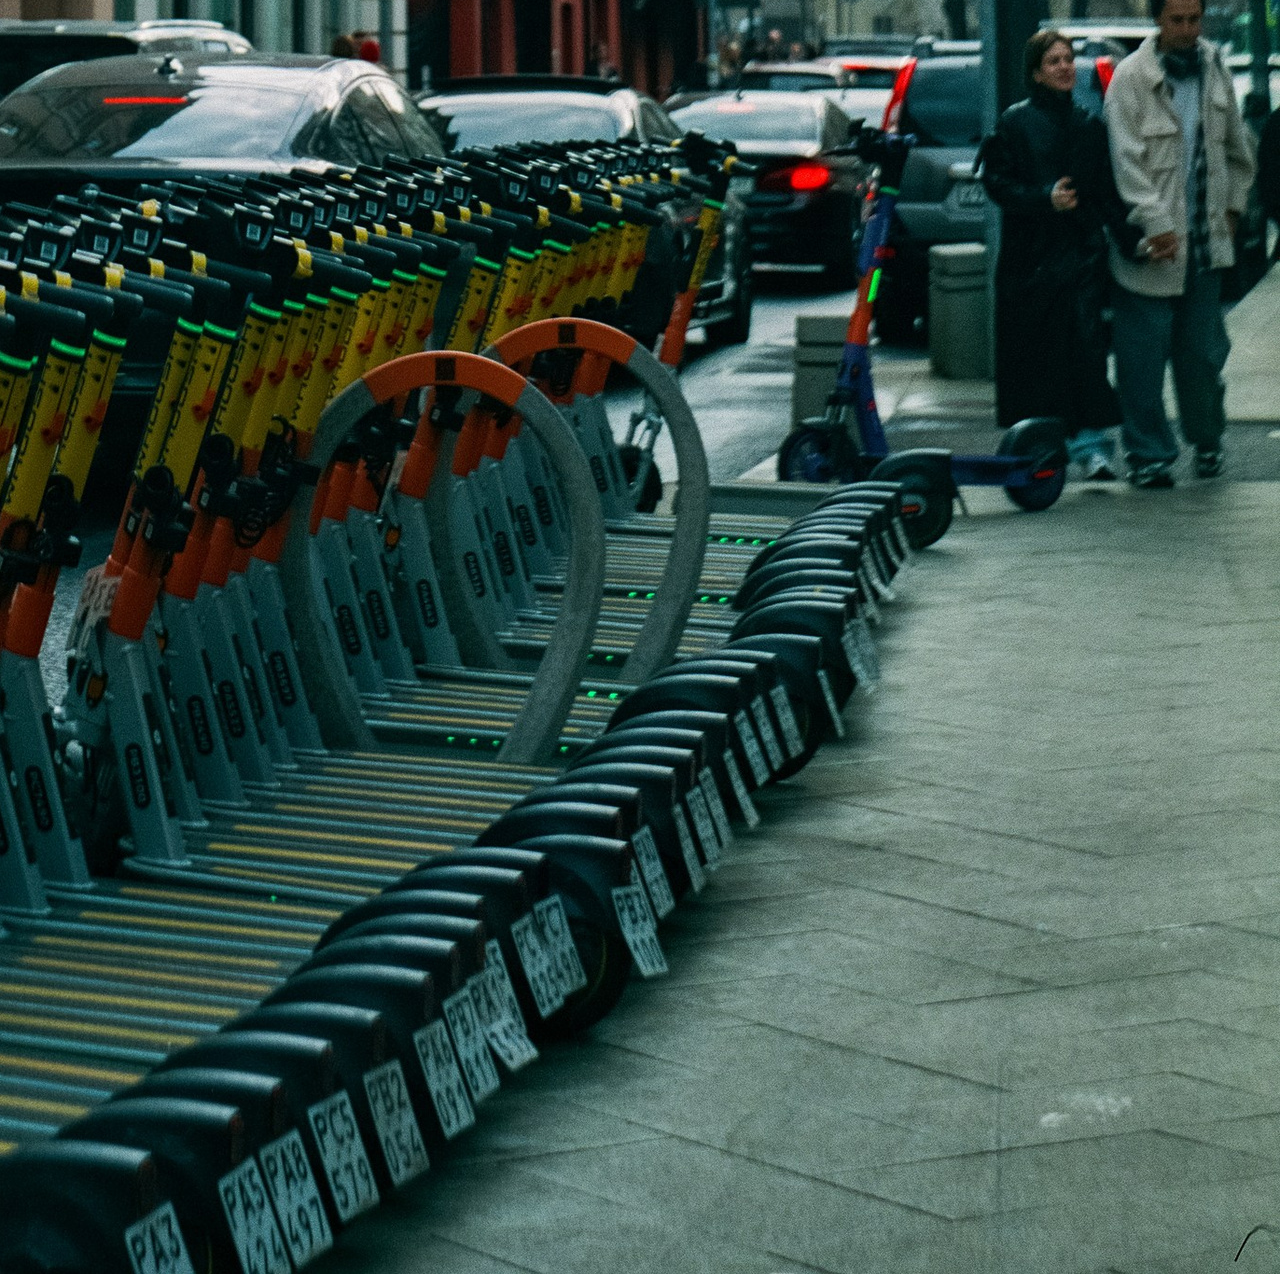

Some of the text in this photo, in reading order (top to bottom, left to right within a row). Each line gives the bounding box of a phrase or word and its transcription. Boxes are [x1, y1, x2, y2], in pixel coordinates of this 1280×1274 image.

[366, 1069, 407, 1121] PB2
[312, 1097, 357, 1155] PC5
[383, 1120, 424, 1177] 054
[222, 1166, 269, 1228] PA5
[263, 1137, 308, 1198] PA8
[330, 1150, 374, 1211] 579
[130, 1211, 181, 1271] PA3
[283, 1193, 328, 1259] 497
